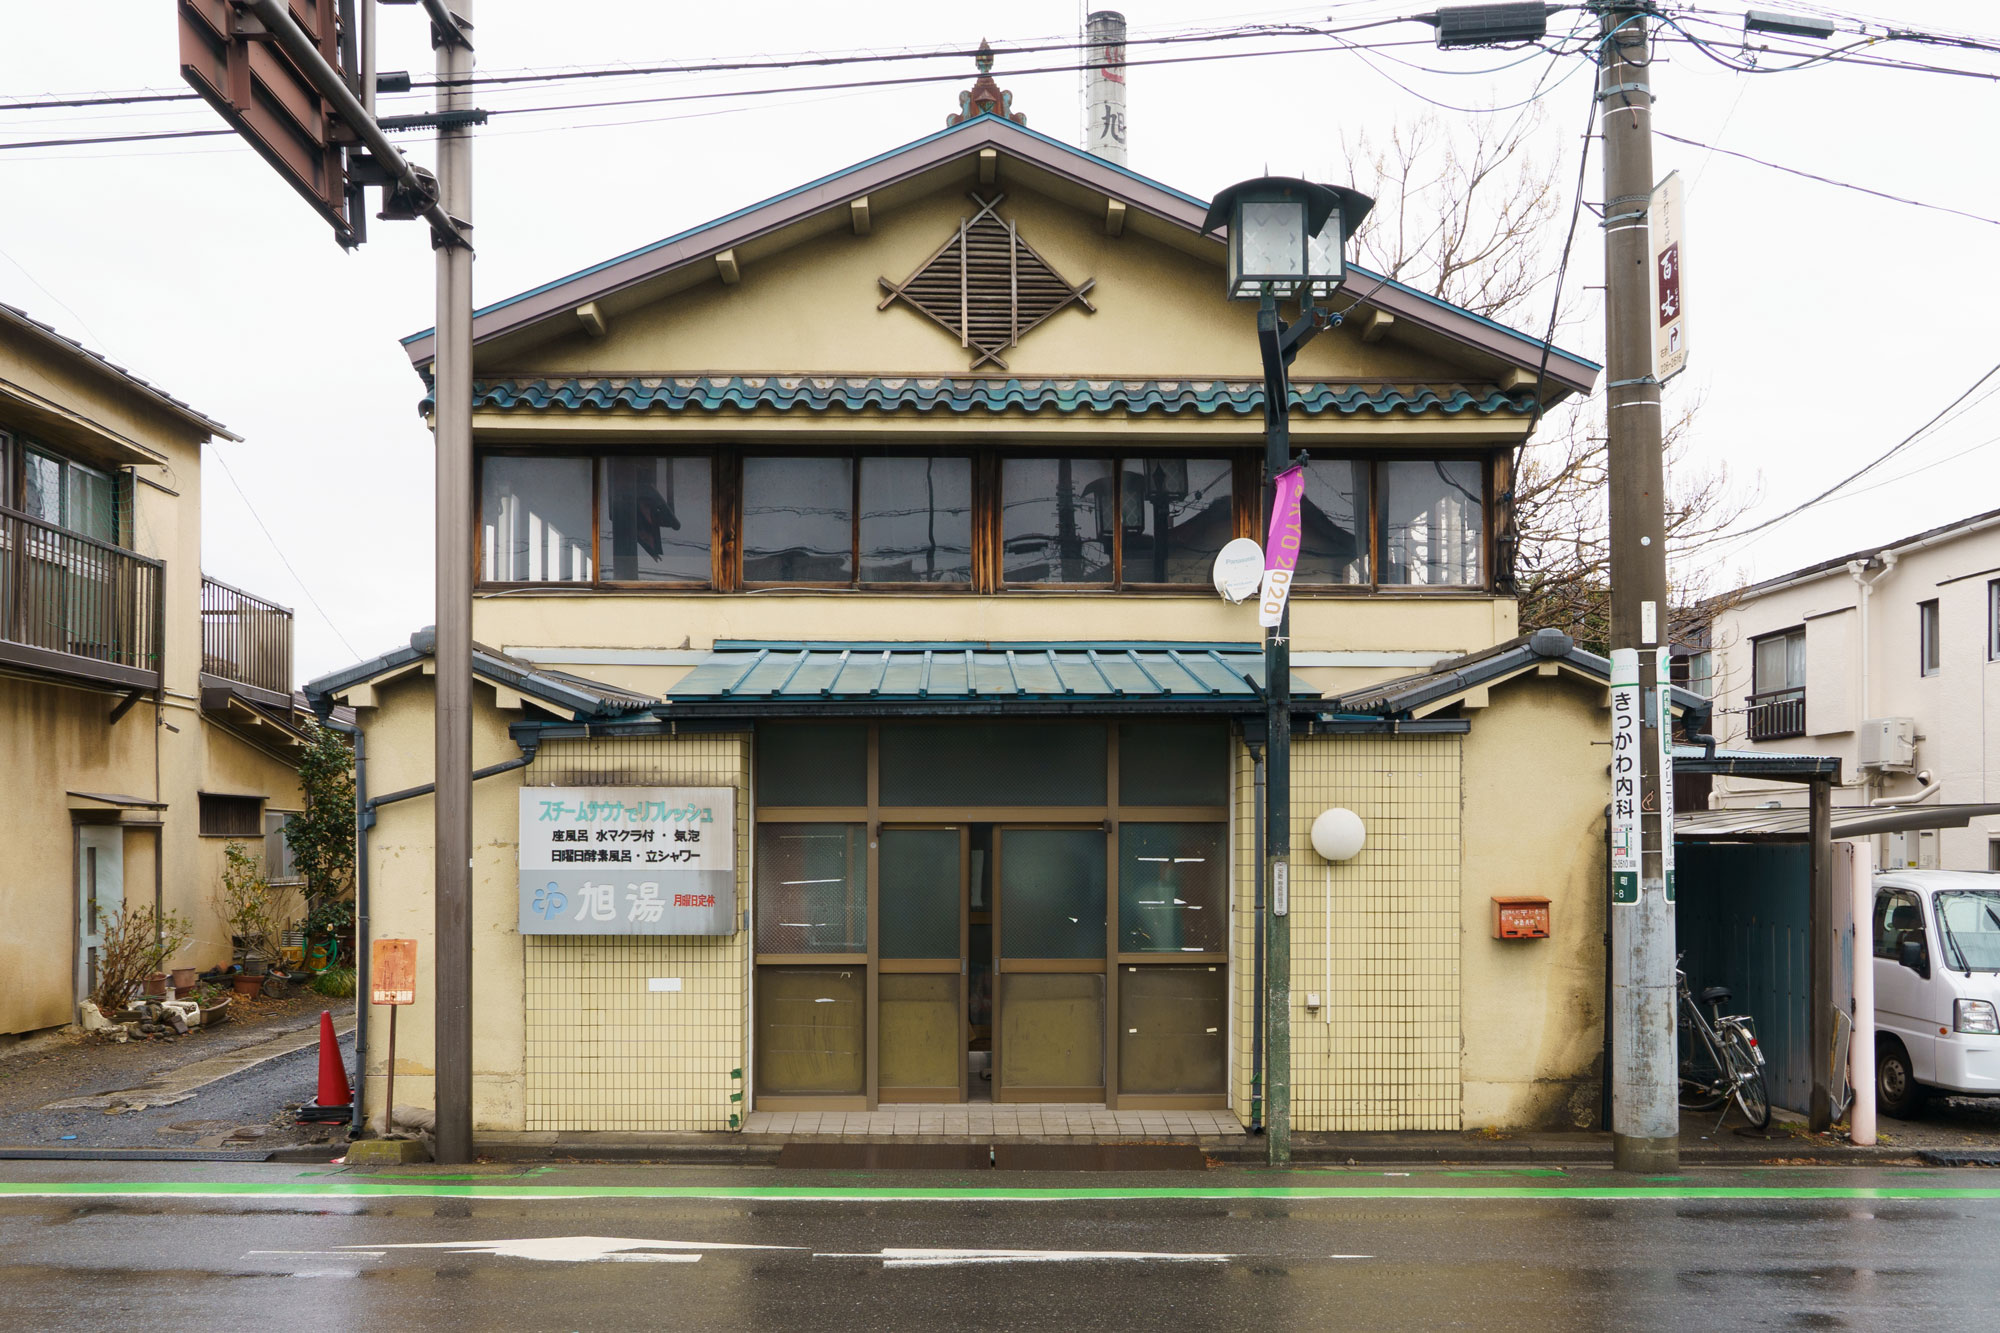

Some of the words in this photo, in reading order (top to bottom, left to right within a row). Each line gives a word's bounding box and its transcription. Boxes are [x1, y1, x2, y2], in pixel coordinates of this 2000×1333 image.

[1101, 105, 1126, 144] 旭
[1264, 555, 1294, 614] 2020
[538, 800, 714, 823] スチームサウナでリフレッシュ
[552, 829, 589, 843] 座風呂
[574, 880, 666, 923] 旭湯
[673, 893, 716, 907] 月曜日定休
